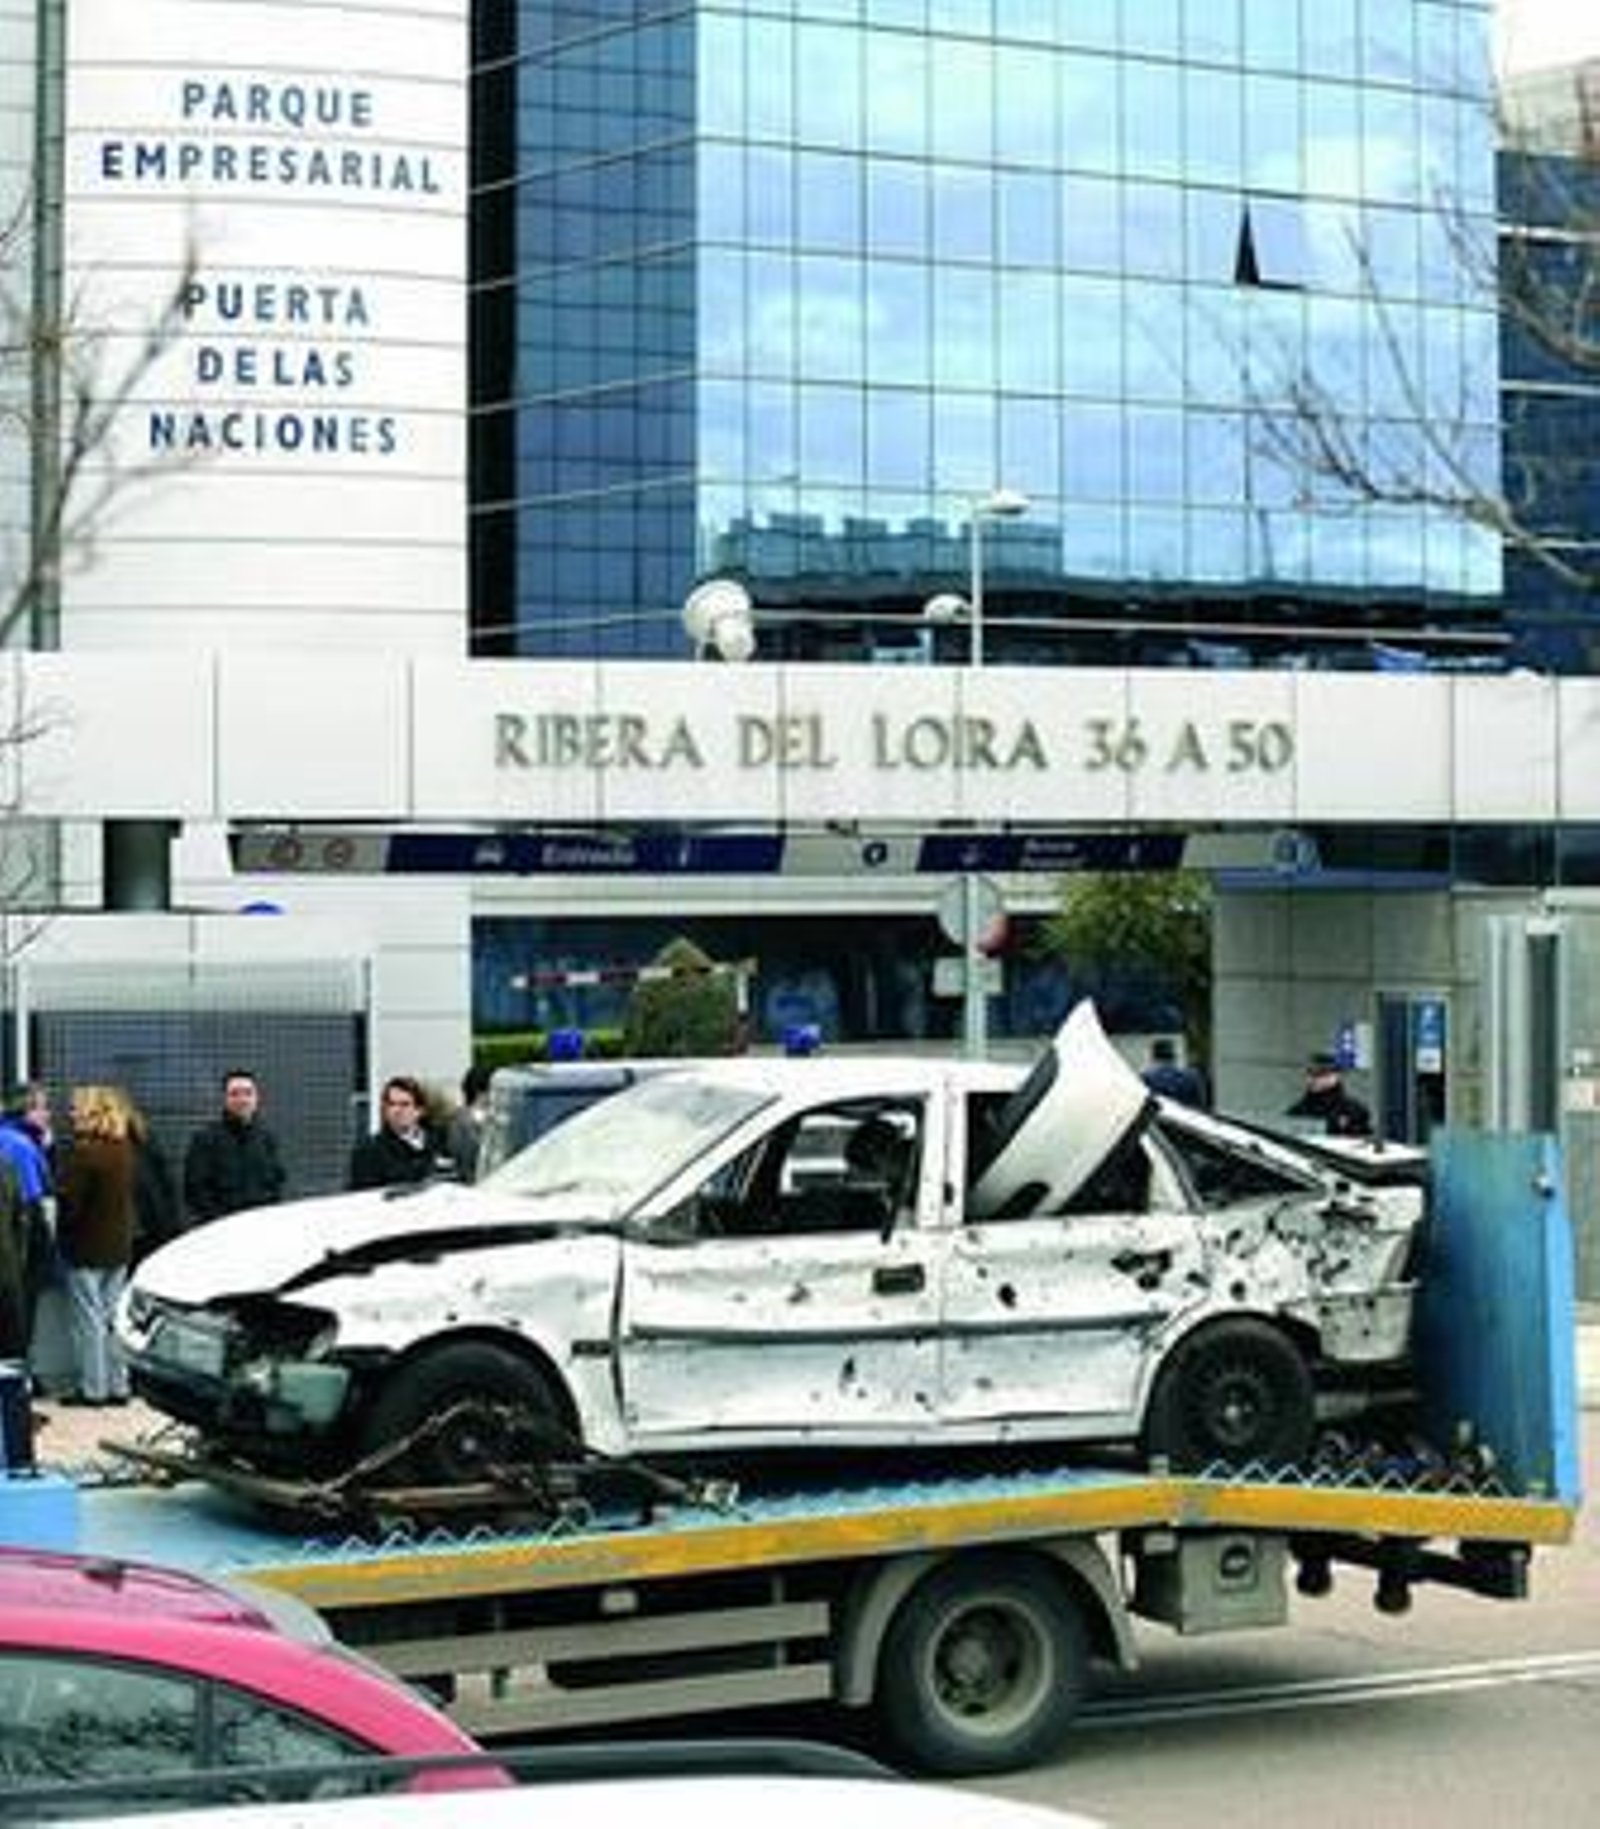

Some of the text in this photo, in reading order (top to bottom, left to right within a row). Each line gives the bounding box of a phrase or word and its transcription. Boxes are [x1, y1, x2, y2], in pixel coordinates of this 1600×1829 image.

[181, 83, 373, 127] PARQUE
[101, 142, 441, 194] EMPRESARIAL
[182, 283, 370, 326] PUERTA
[197, 346, 355, 387] DE LAS
[149, 411, 397, 454] NACIONES
[494, 713, 1295, 773] RIBERA DEL LOIRA 36 A 50
